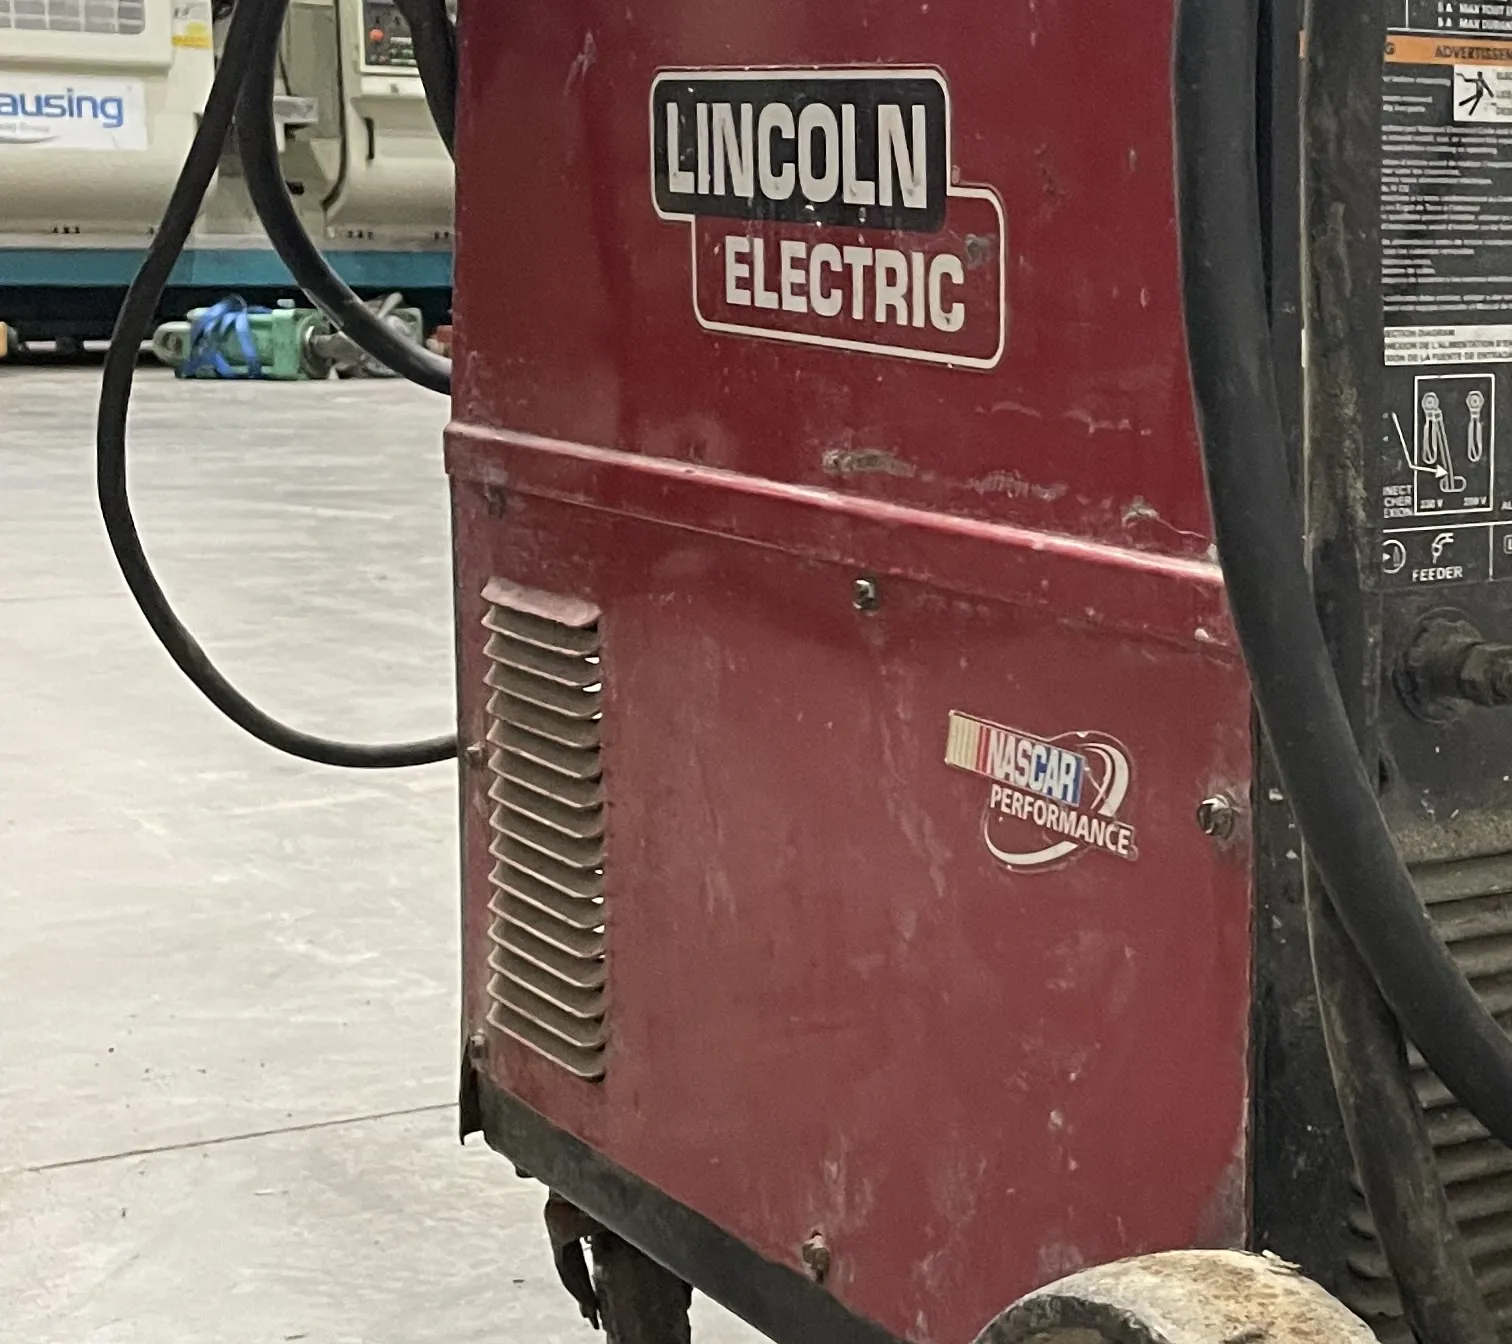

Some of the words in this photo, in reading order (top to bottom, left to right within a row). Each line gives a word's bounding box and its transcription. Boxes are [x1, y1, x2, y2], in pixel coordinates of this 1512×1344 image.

[667, 102, 927, 208] LINCOLN
[726, 236, 964, 332] ELECTRIC
[1412, 565, 1463, 581] FEEDER
[987, 730, 1076, 802] NASCAR
[990, 784, 1131, 855] PERFORMANCE
